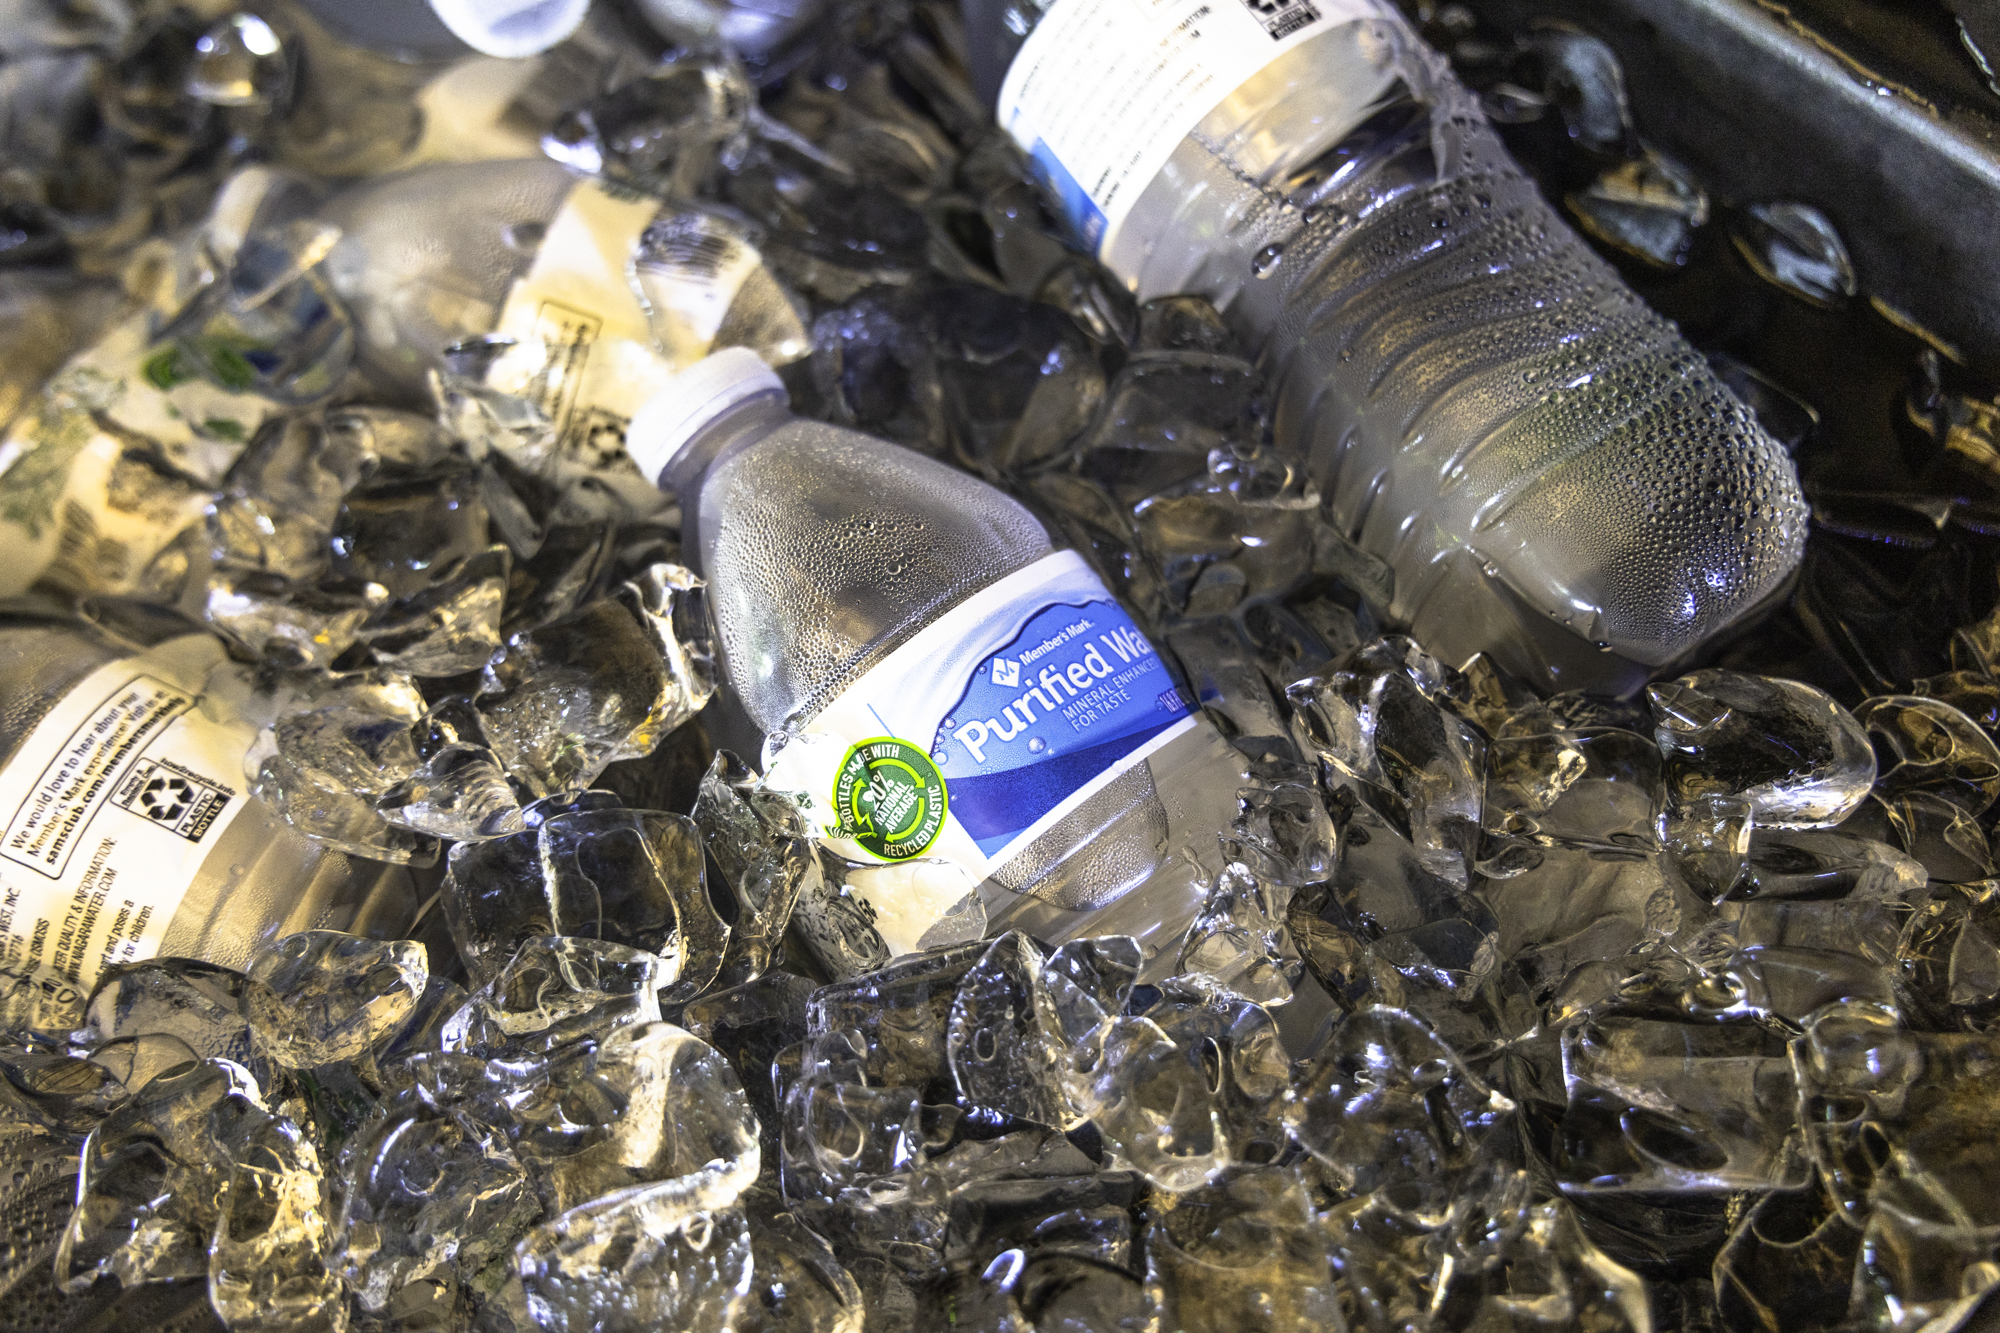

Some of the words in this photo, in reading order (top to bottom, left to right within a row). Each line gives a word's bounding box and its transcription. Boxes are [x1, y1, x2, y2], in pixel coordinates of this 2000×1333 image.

[1019, 631, 1069, 666] Member's
[953, 643, 1114, 764] Purified
[1062, 684, 1115, 720] MINERAL
[1112, 658, 1158, 688] ENHANCED
[1071, 709, 1099, 731] FOR
[1095, 689, 1131, 715] TASTE
[871, 744, 900, 759] WITH
[10, 830, 31, 849] We
[26, 792, 53, 828] would
[45, 770, 70, 793] love
[64, 757, 79, 769] to
[72, 733, 97, 757] hear
[94, 708, 122, 734] about
[160, 757, 236, 796] how2recycle.info
[27, 803, 69, 857] Member's
[61, 776, 86, 802] Mark
[180, 793, 214, 833] PLASTIC
[194, 800, 224, 837] BOTTLE
[838, 773, 854, 826] BOTTLES
[875, 781, 910, 826] NATIONAL
[924, 784, 943, 834] PLASTIC
[884, 828, 931, 857] RECYCLED
[74, 837, 118, 904] INFORMATION:
[5, 887, 21, 907] INC.
[70, 904, 83, 914] &
[30, 918, 50, 957] OSMOSIS
[57, 912, 80, 951] QUALITY
[105, 934, 119, 954] and
[112, 907, 130, 938] poses
[124, 899, 134, 907] a
[129, 904, 154, 943] children.
[53, 949, 69, 972] ATER
[122, 943, 137, 957] for
